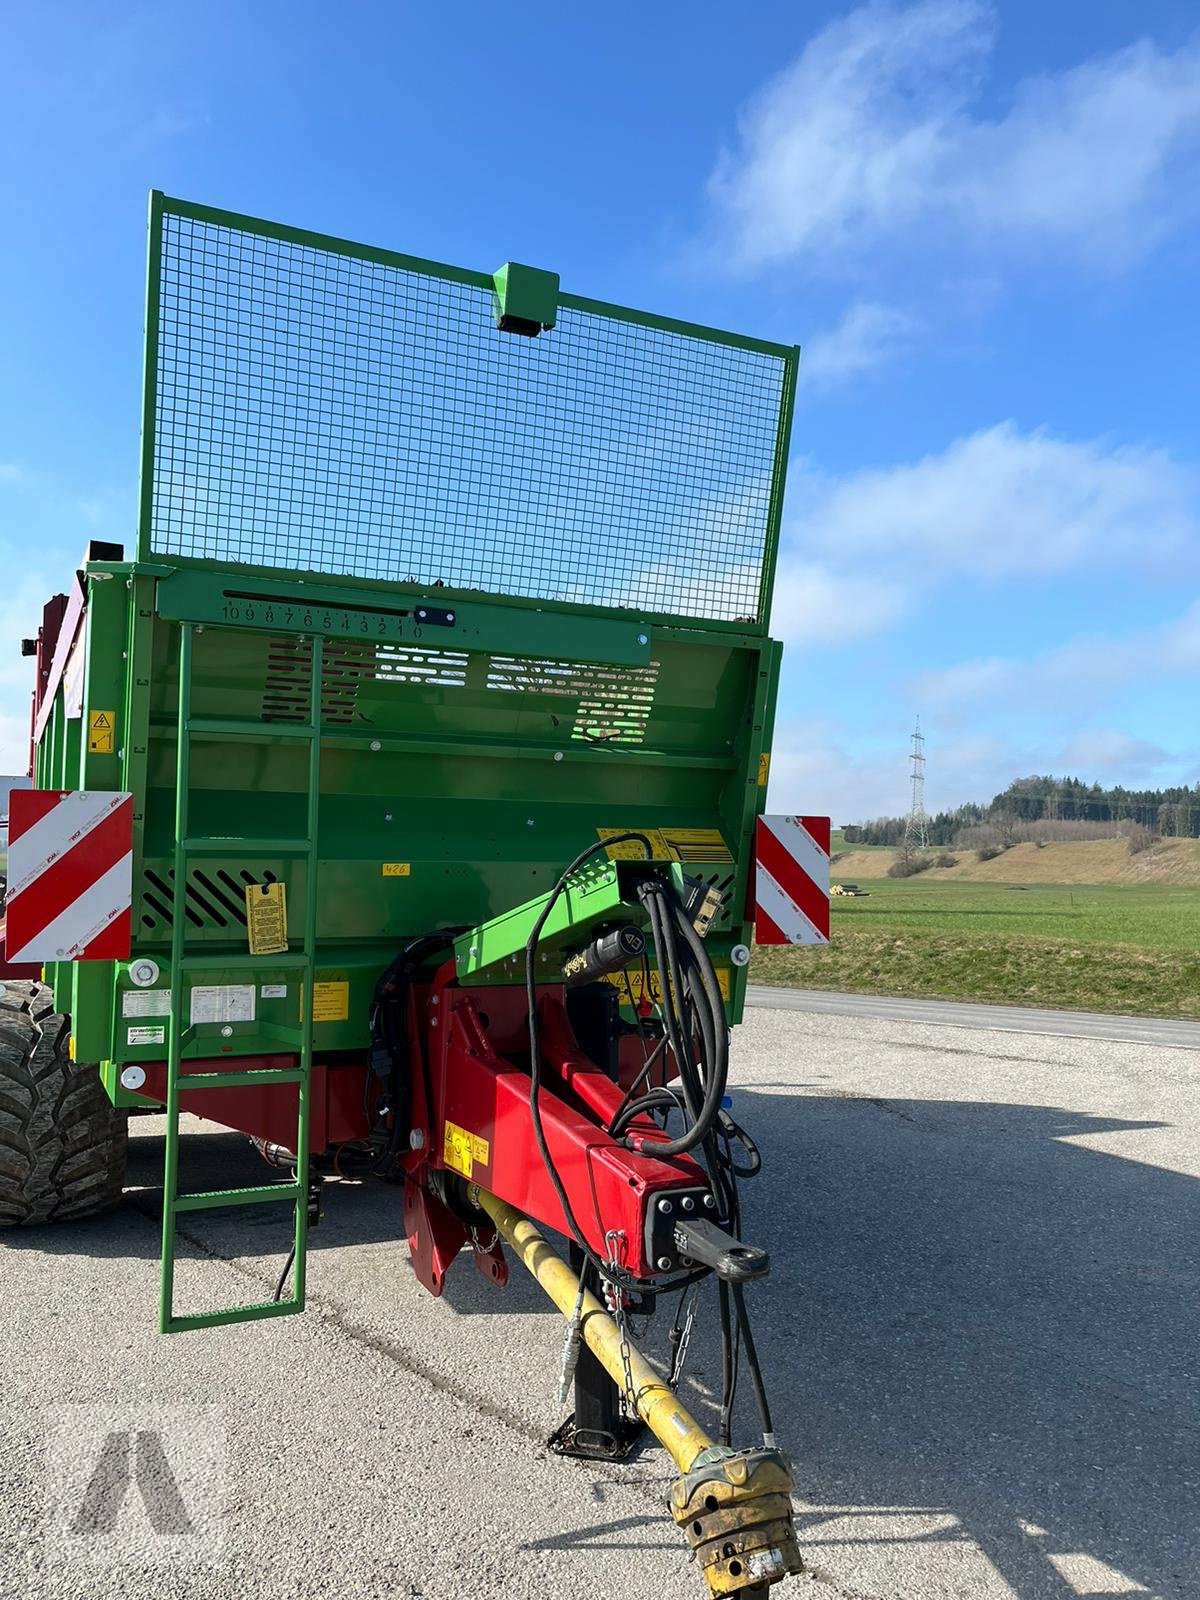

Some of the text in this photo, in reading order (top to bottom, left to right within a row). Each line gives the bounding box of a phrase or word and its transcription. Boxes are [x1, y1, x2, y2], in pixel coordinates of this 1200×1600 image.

[223, 606, 423, 638] 10 9 8 7 6 5 4 3 2 1 0
[384, 864, 408, 874] 426
